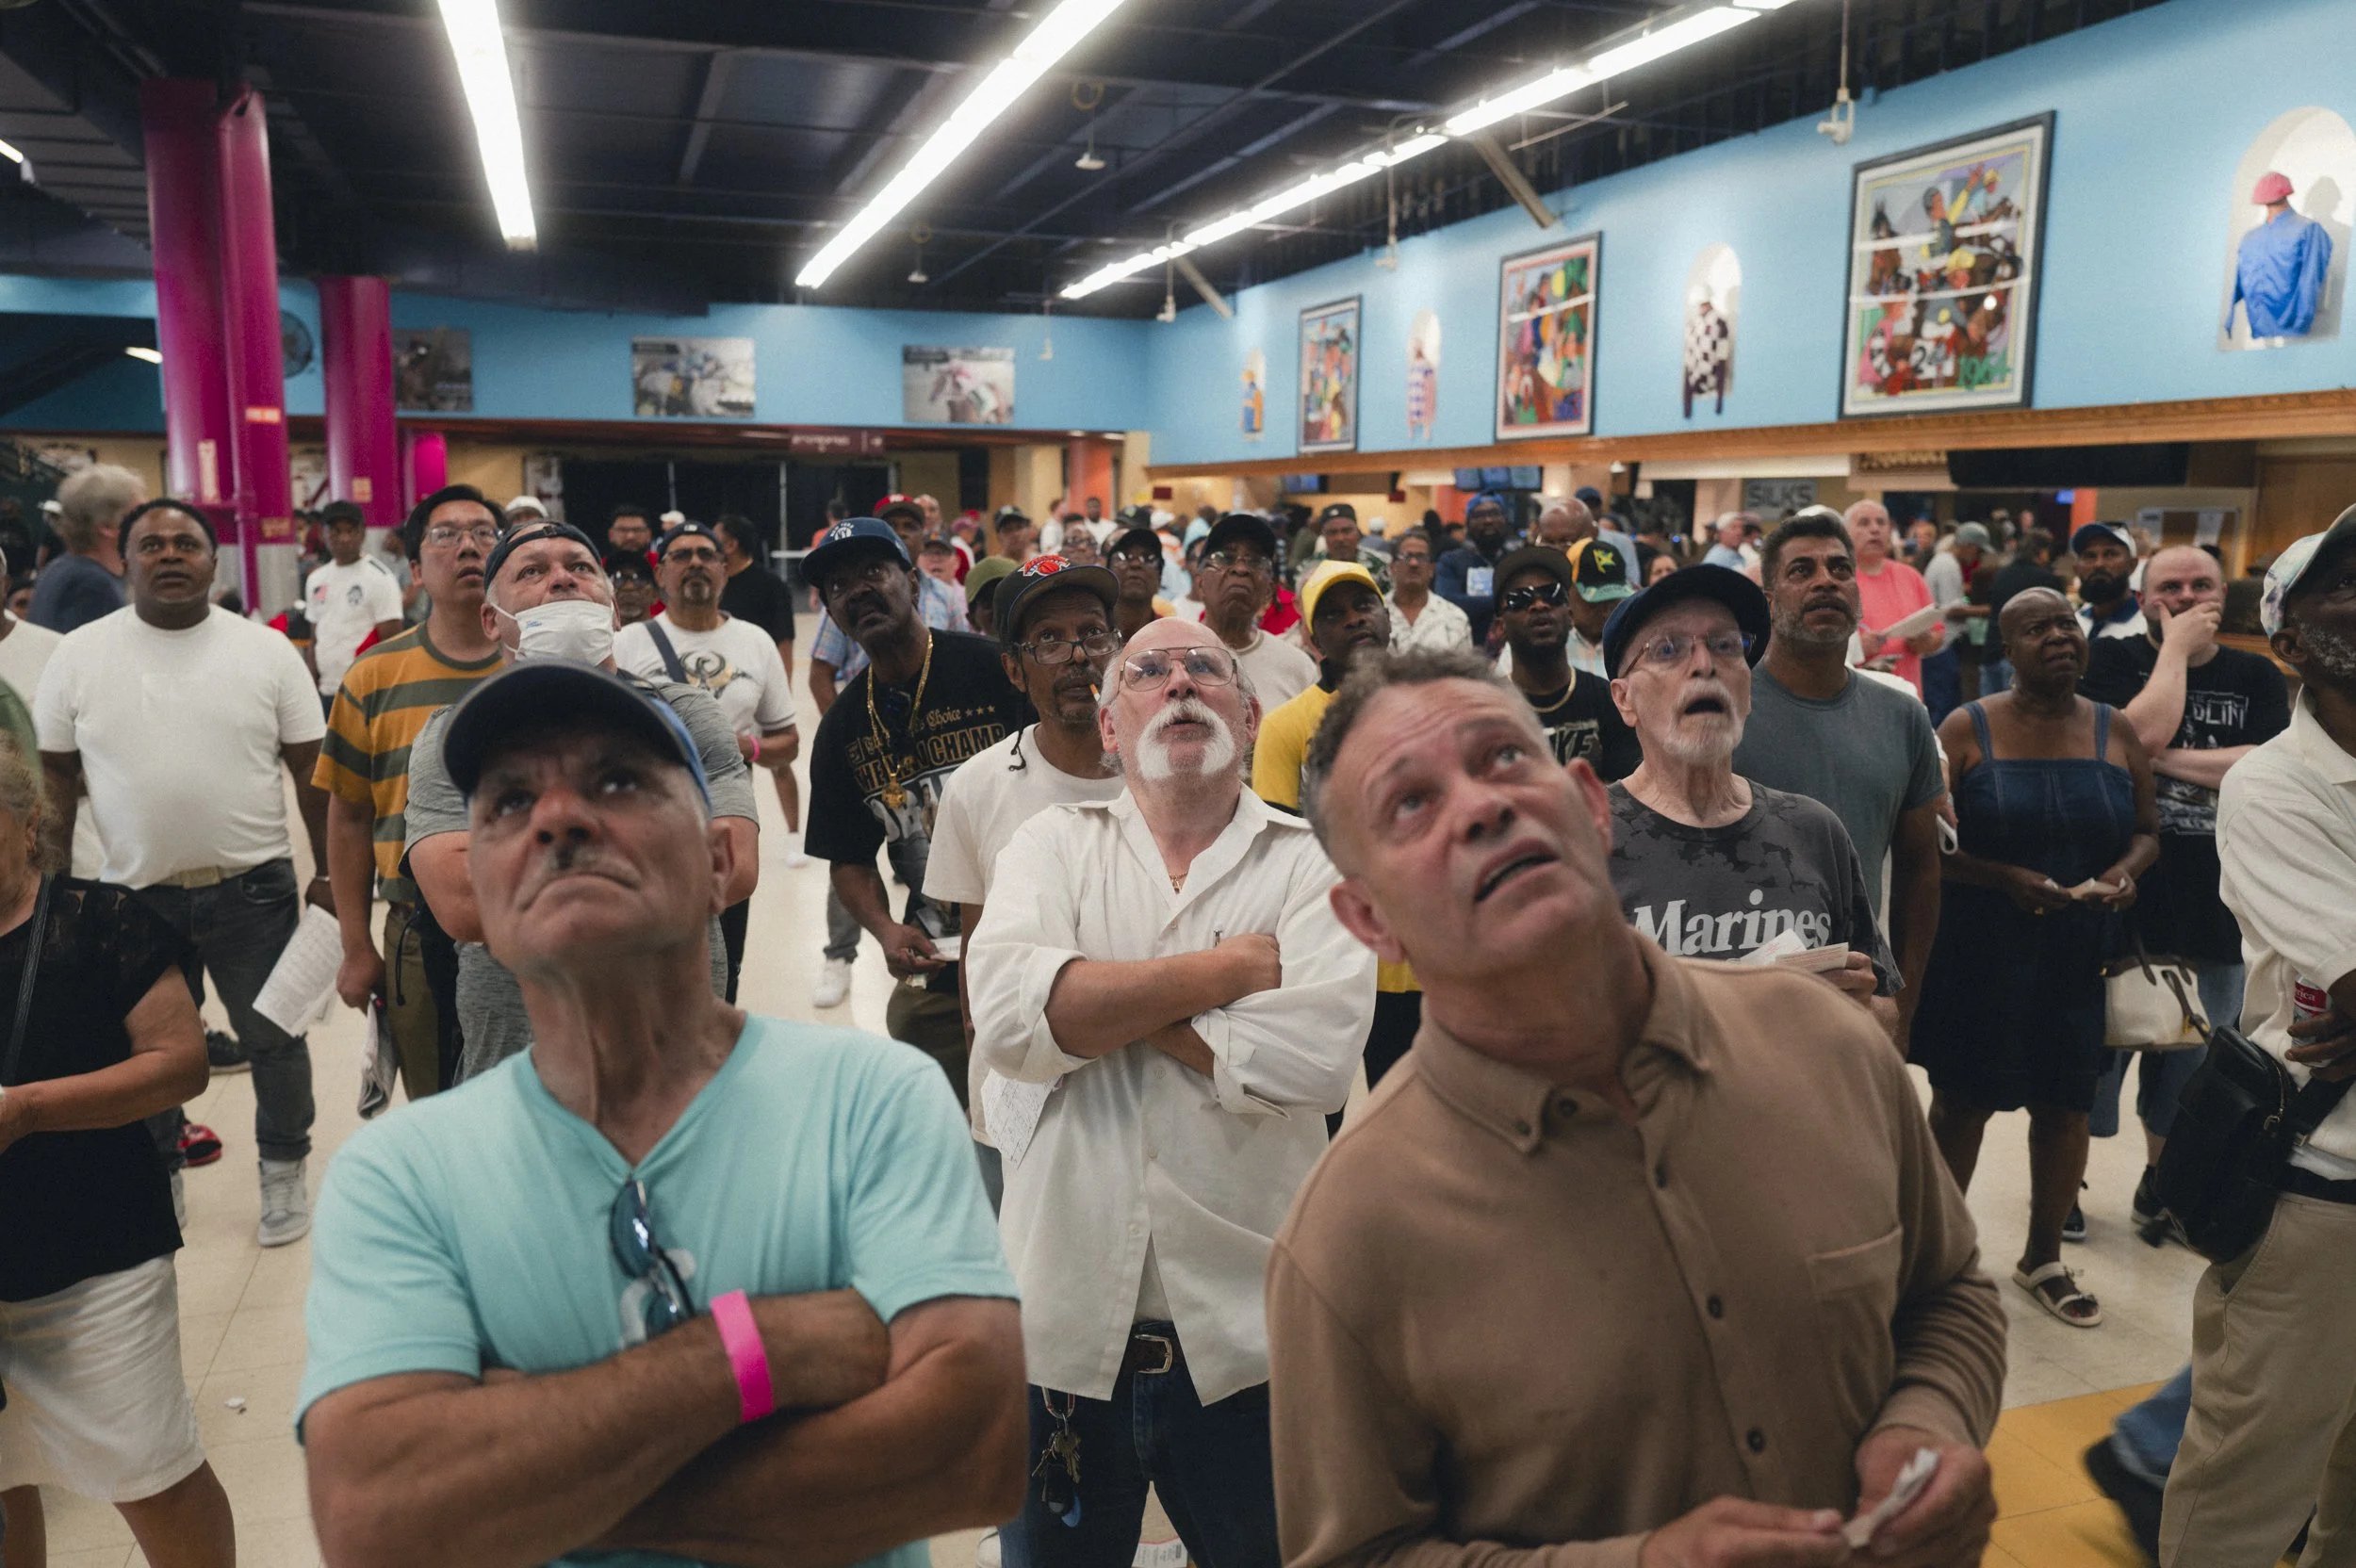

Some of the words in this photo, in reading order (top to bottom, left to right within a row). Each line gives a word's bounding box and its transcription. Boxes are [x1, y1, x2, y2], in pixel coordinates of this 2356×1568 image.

[1748, 483, 1813, 508] SILKS
[927, 723, 1006, 766] CHAMP
[1634, 889, 1832, 957] Marines
